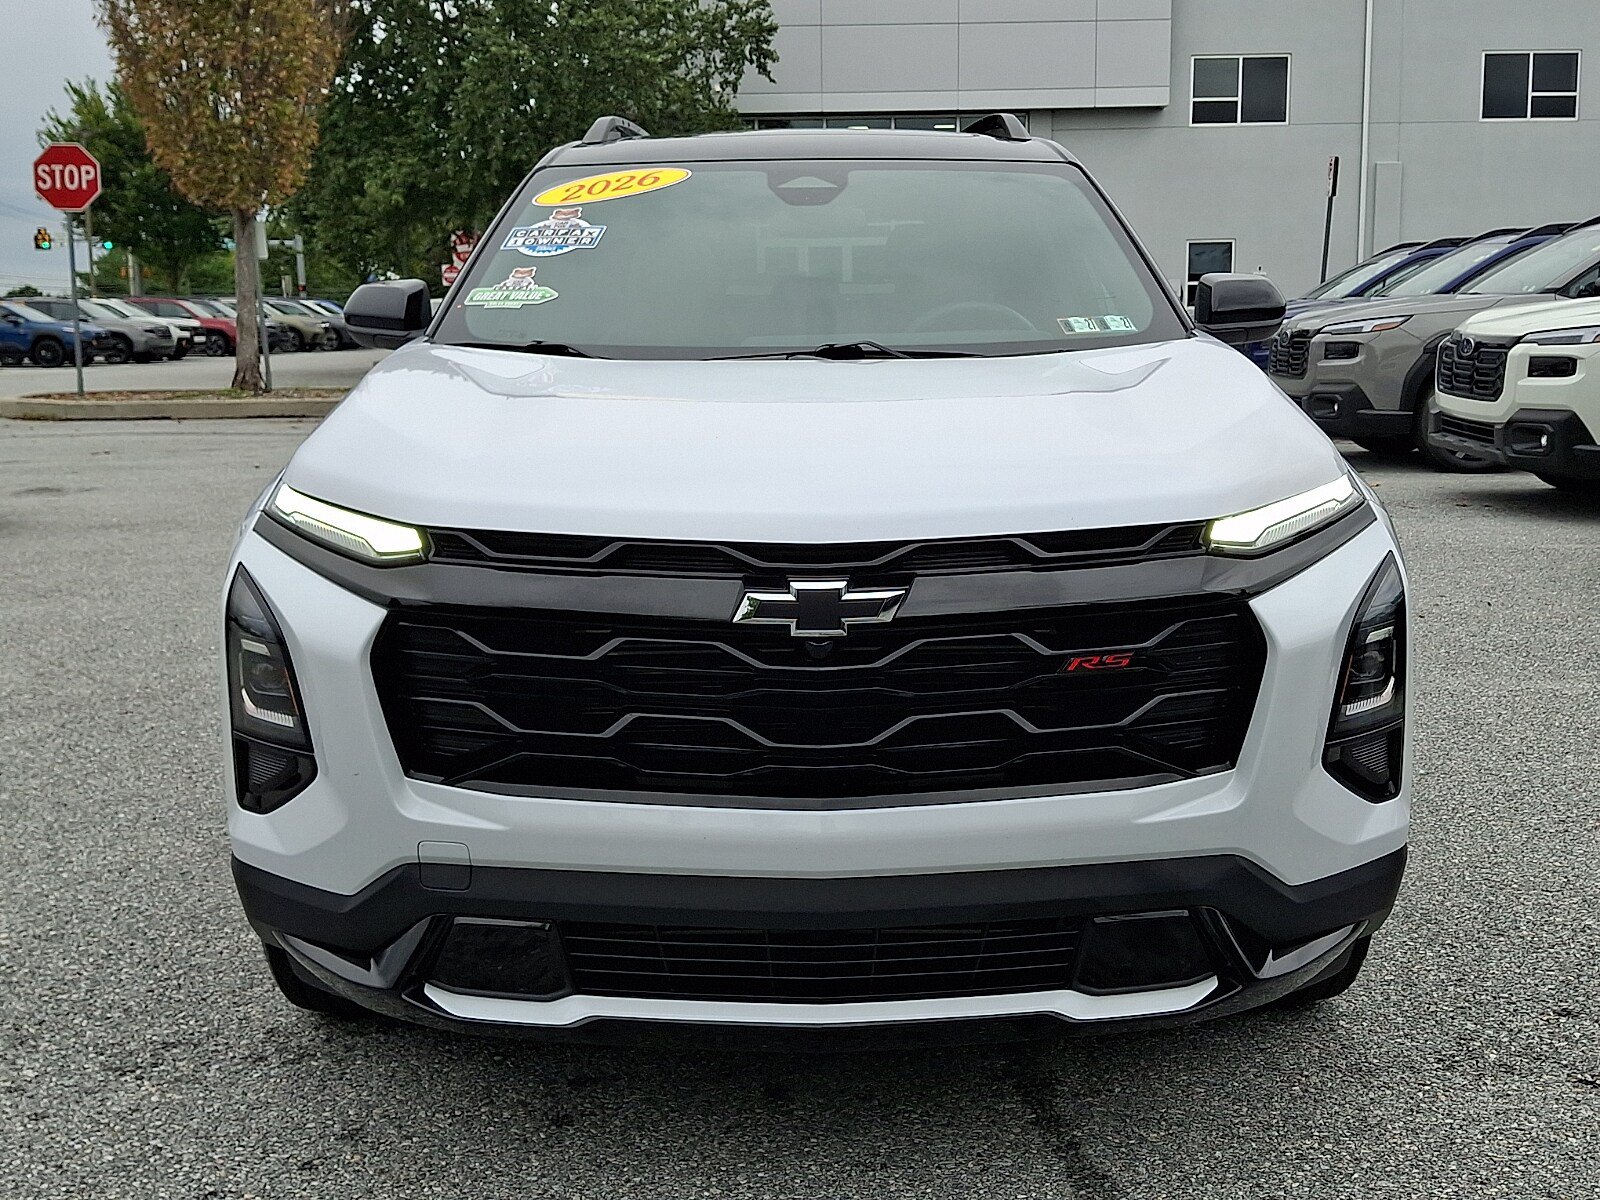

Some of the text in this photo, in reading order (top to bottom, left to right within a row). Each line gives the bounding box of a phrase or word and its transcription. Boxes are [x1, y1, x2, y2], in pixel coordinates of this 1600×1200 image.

[37, 164, 96, 190] STOP
[559, 170, 664, 203] 2026
[515, 228, 597, 237] CARFAX
[524, 237, 592, 246] OWNER
[472, 290, 546, 301] GREAT VALUE
[1065, 651, 1135, 672] RS
